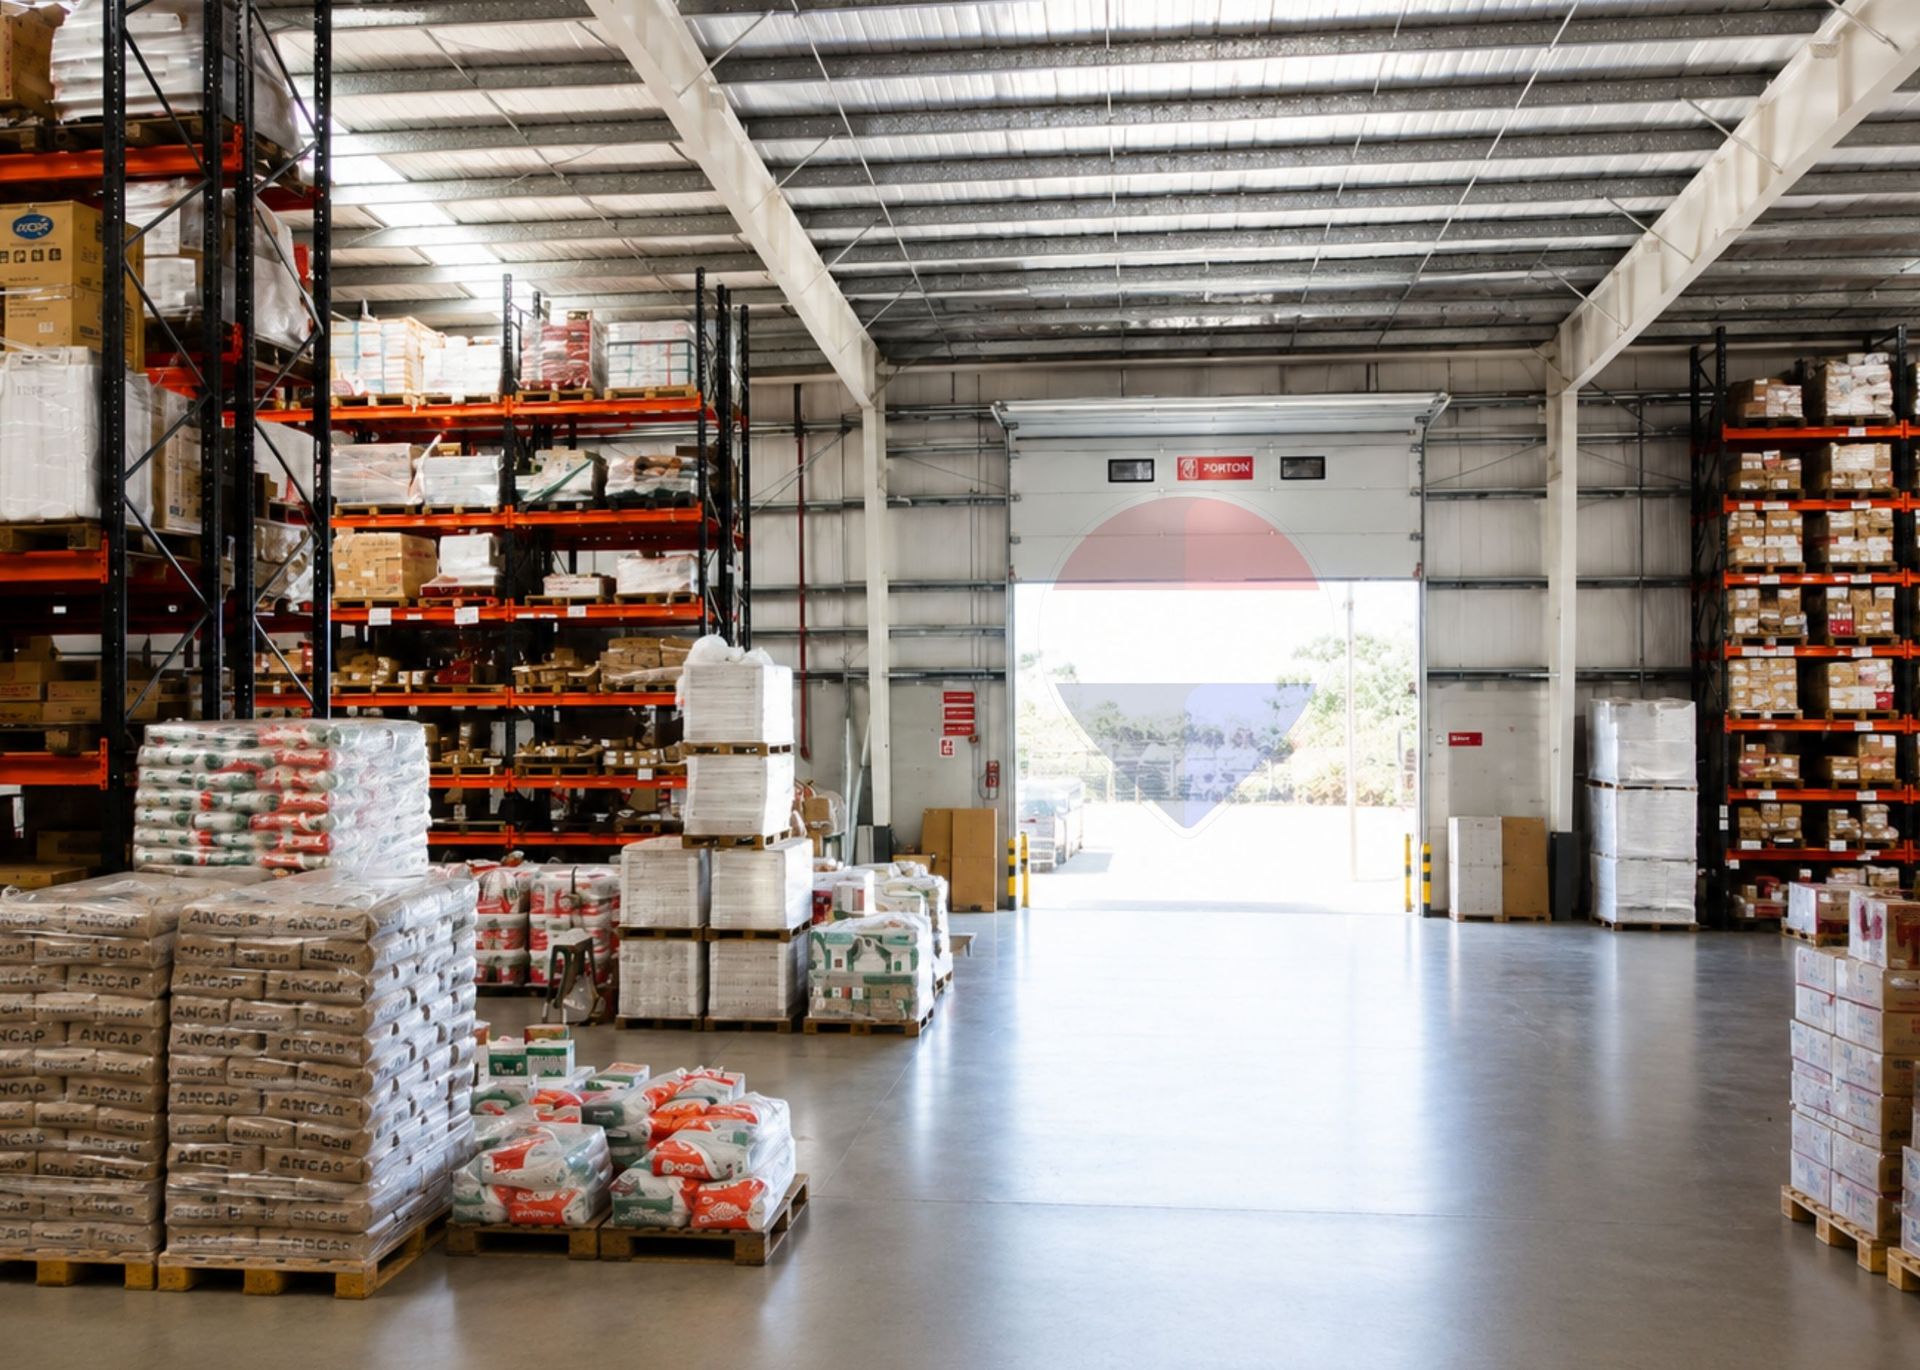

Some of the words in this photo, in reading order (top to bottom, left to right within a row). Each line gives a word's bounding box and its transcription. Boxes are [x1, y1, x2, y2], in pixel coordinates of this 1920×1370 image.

[1203, 462, 1250, 473] PORTON
[77, 972, 141, 989] ANCAP
[80, 1029, 143, 1045] ANCAP
[177, 1033, 241, 1049] ANCAP
[177, 1092, 240, 1106] ANCAP
